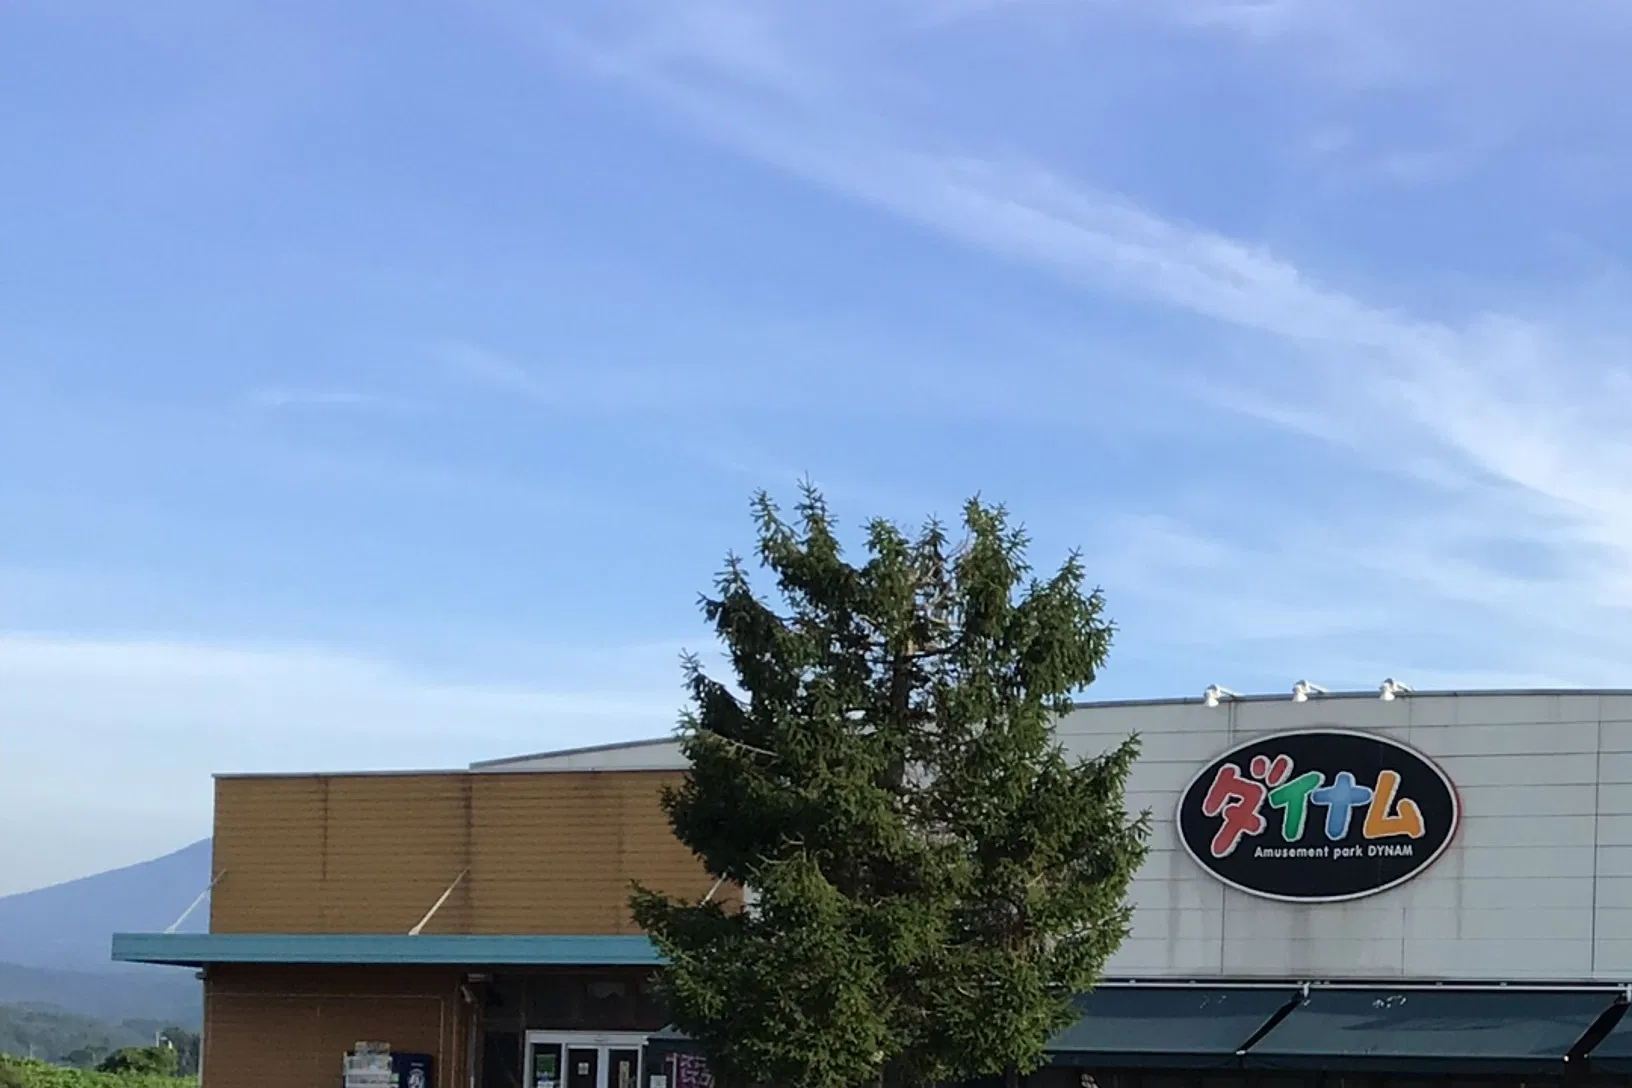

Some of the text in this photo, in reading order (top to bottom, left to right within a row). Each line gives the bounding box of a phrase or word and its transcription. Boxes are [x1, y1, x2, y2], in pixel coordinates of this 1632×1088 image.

[1202, 754, 1425, 858] ダイナム
[1253, 844, 1413, 860] Amusement park DYNAM
